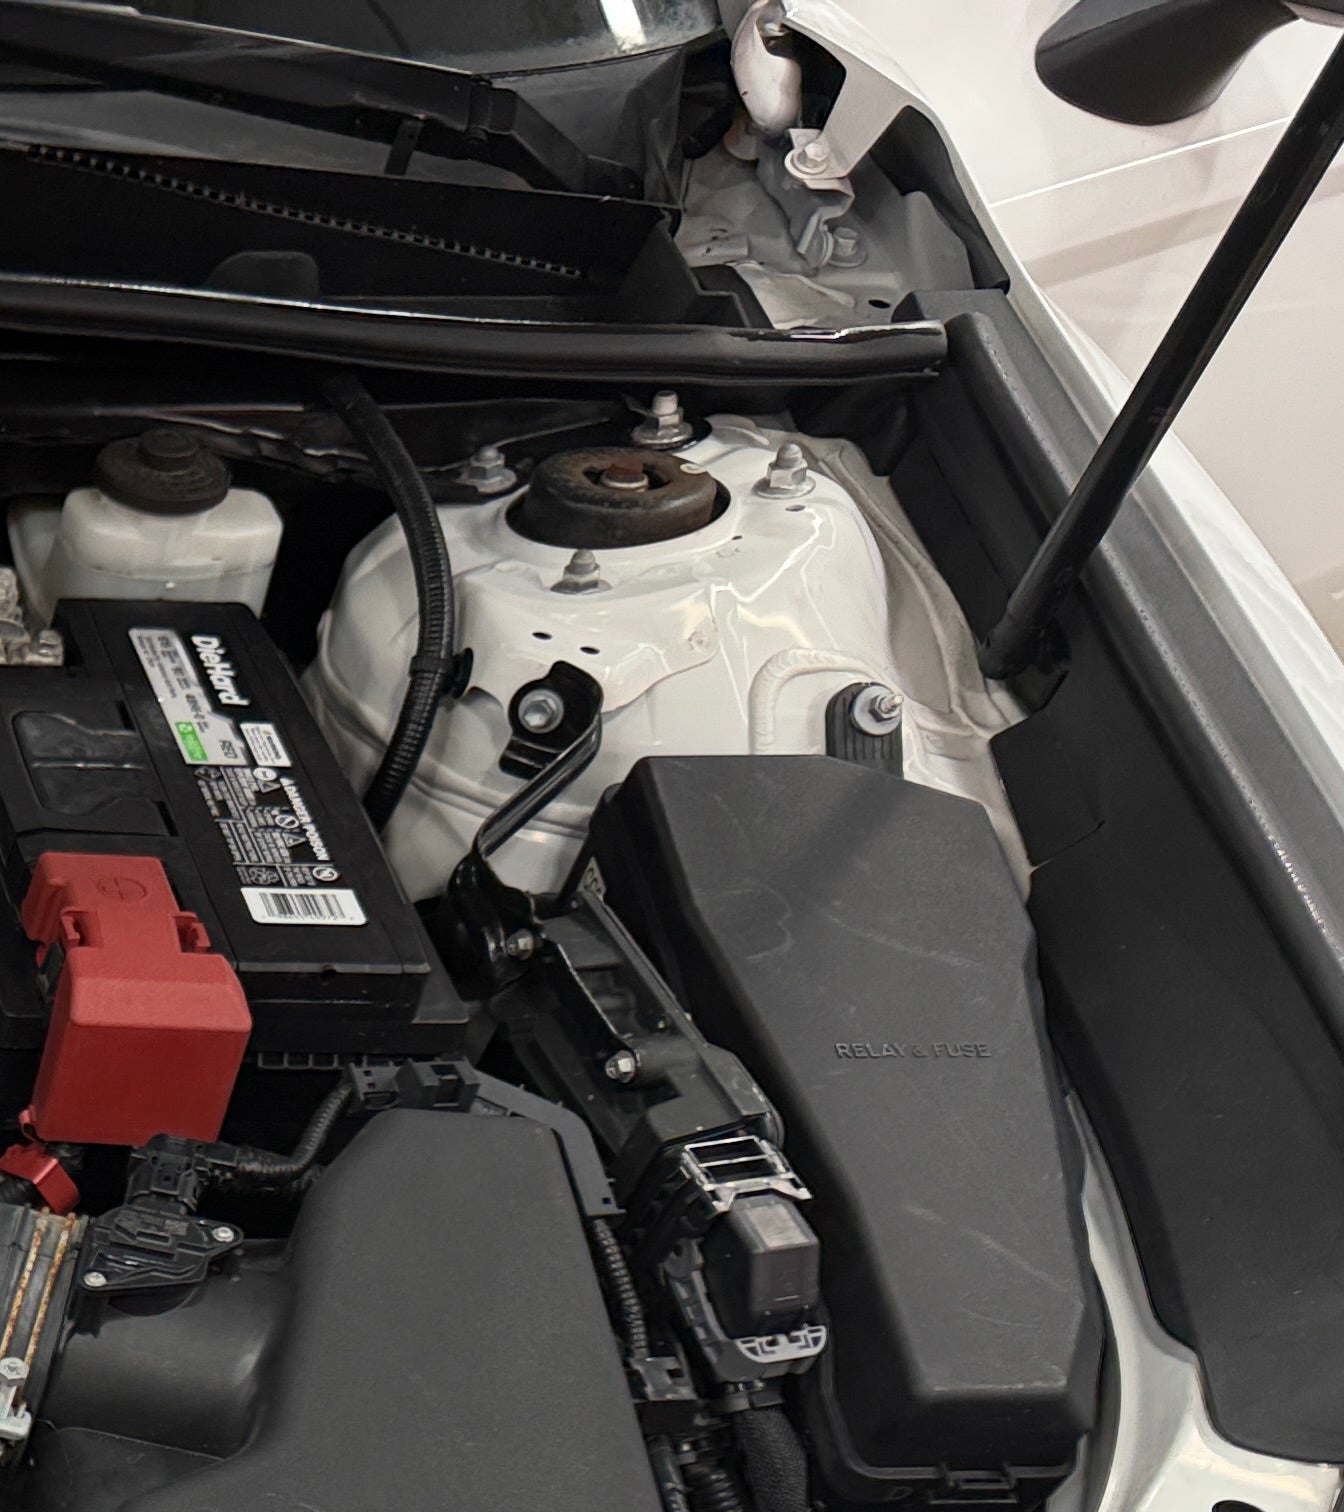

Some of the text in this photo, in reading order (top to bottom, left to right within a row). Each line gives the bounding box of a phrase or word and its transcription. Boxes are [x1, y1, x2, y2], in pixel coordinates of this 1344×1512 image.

[191, 635, 250, 706] DieHard
[302, 823, 330, 861] POISON
[834, 1042, 992, 1059] RELAY & FUSE
